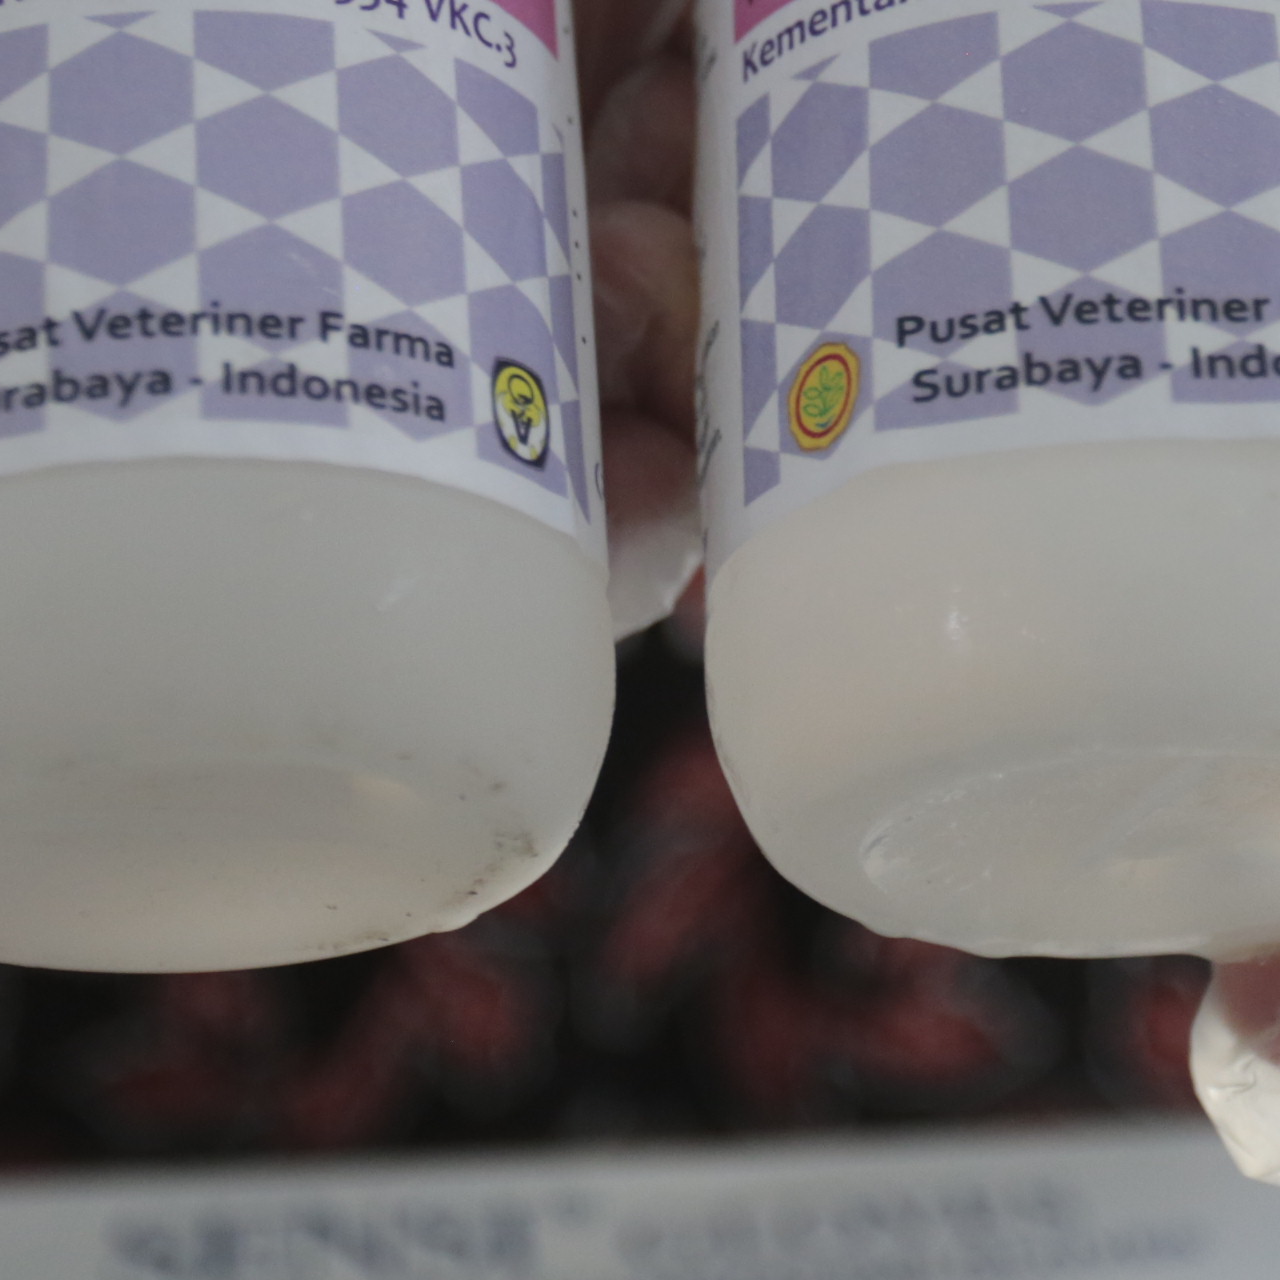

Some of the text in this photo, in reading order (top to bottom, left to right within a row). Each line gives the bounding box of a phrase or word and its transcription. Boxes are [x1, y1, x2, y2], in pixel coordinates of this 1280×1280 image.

[70, 300, 305, 344] Veteriner
[320, 310, 456, 369] Farma
[895, 301, 1028, 350] Pusat
[1038, 288, 1270, 328] Veteriner
[223, 361, 446, 423] Indonesia
[912, 350, 1143, 405] Surabaya
